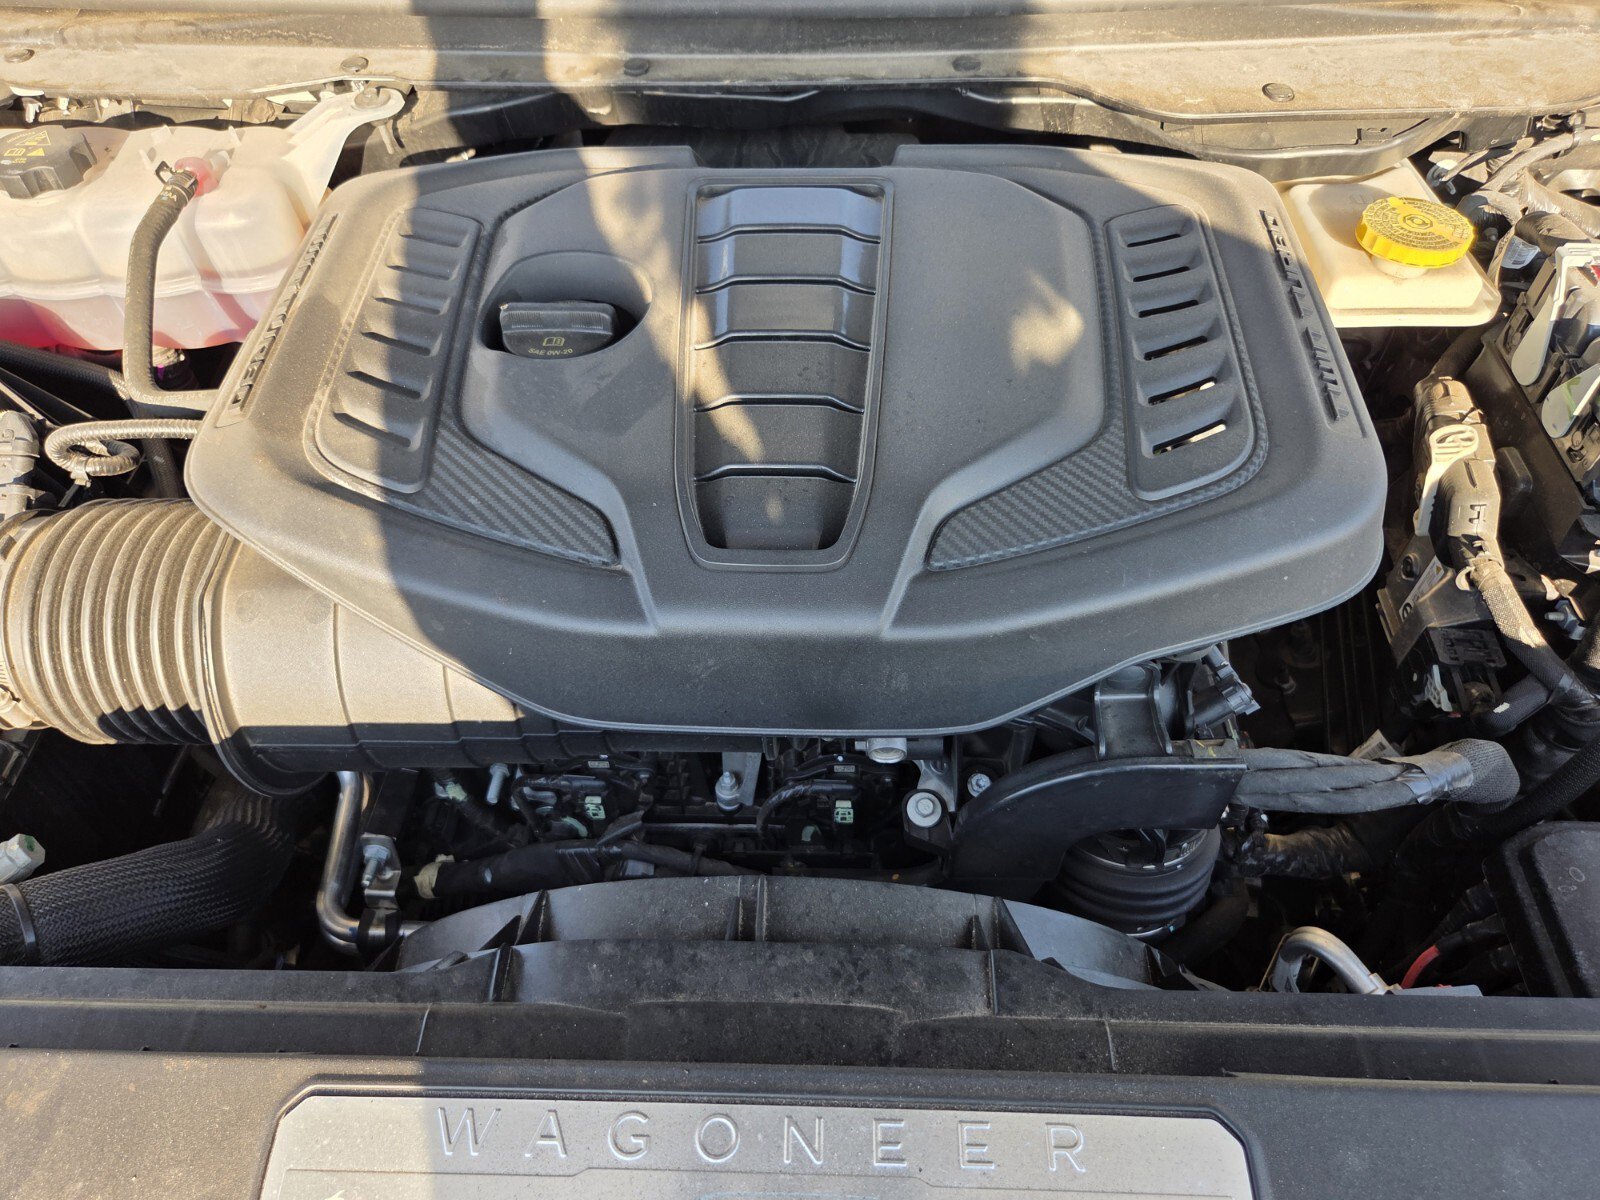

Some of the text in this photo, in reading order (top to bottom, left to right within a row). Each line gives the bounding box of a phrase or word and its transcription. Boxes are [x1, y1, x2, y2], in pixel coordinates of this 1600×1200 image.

[527, 347, 574, 356] SAE 0W-20
[436, 1106, 1088, 1173] WAGONEER
